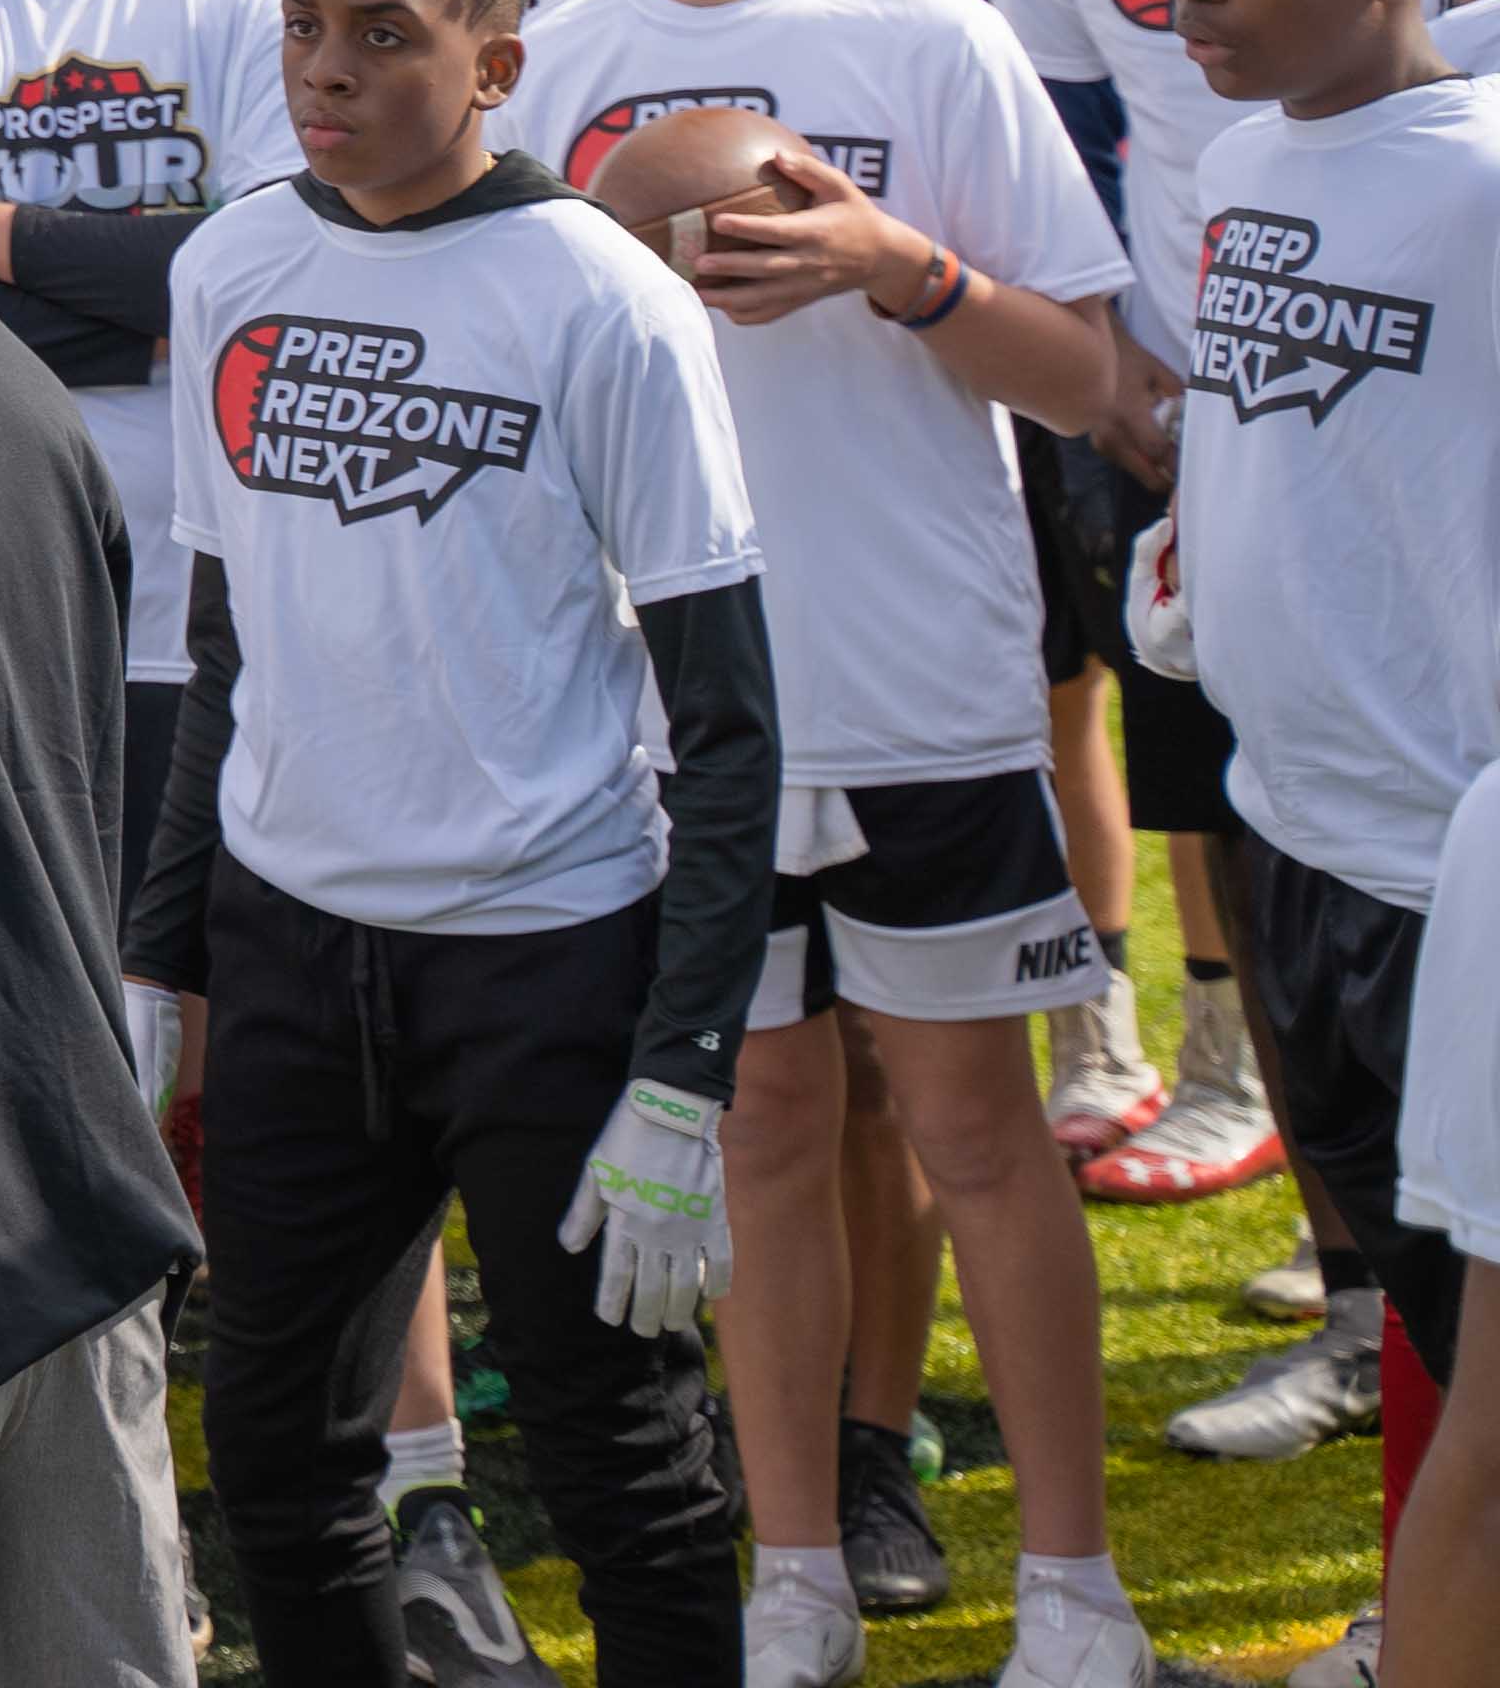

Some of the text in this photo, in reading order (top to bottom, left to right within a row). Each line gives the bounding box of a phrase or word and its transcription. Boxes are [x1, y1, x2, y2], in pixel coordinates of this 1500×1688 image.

[1213, 218, 1312, 274] PREP
[1200, 273, 1420, 361] REDZONE
[274, 326, 417, 381] PREP
[1190, 329, 1281, 393] NEXT
[260, 378, 528, 458] REDZONE
[251, 431, 391, 494] NEXT
[1015, 924, 1093, 984] NIKE
